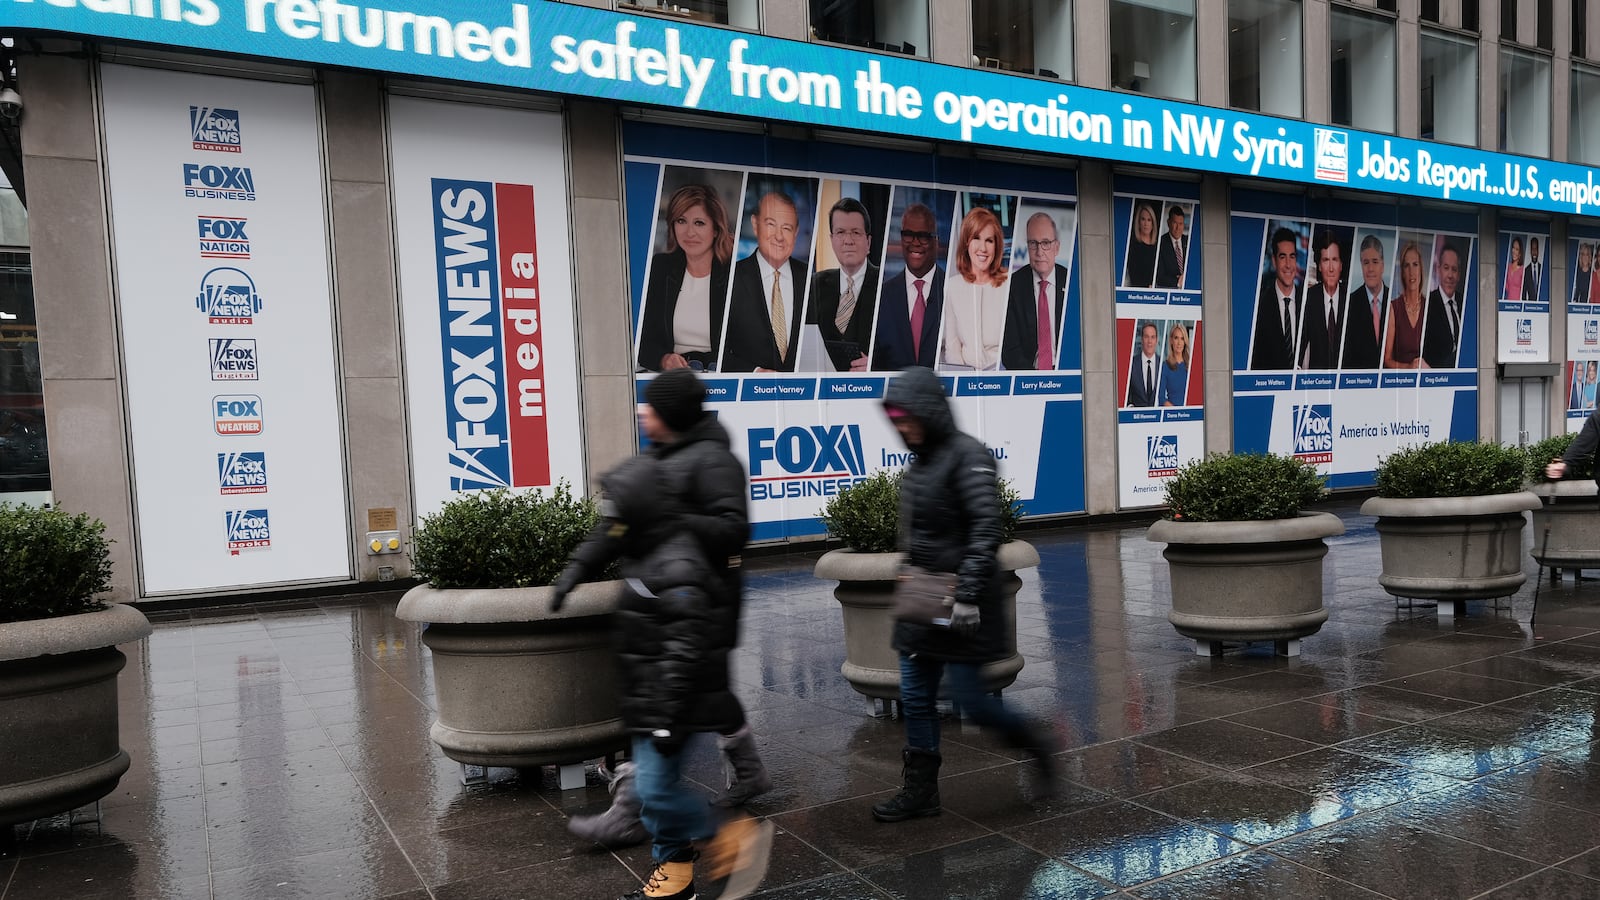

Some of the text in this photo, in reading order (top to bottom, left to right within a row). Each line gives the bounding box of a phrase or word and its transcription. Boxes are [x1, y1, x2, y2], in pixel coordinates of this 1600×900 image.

[245, 0, 532, 68] returned
[550, 21, 715, 107] safely
[727, 39, 842, 109] from
[853, 60, 922, 119] the
[933, 94, 1112, 143] operation
[1123, 104, 1152, 148] in
[1161, 110, 1224, 159] NW
[1232, 119, 1303, 175] Syria
[206, 116, 238, 131] FOX
[199, 130, 240, 144] NEWS
[194, 143, 241, 152] channel
[1356, 141, 1410, 184] Jobs
[183, 163, 243, 189] FOX
[185, 189, 256, 201] BUSINESS
[198, 219, 248, 240] FOX
[200, 241, 250, 253] NATION
[221, 292, 249, 307] FOX
[214, 305, 251, 316] NEWS
[440, 187, 501, 450] FOX NEWS
[505, 252, 543, 418] media
[226, 348, 254, 360] FOX
[219, 360, 255, 371] NEWS
[216, 372, 255, 380] digital
[753, 384, 805, 396] Stuart Varney
[831, 383, 873, 393] Neil Cavuto
[968, 382, 977, 390] Liz
[1021, 380, 1062, 391] Larry Kudlow
[216, 400, 259, 417] FOX
[218, 422, 260, 433] WEATHER
[1306, 416, 1330, 434] FOX
[1340, 420, 1430, 438] America is Watching
[1299, 434, 1331, 451] NEWS
[747, 425, 847, 476] FOX
[1157, 444, 1177, 456] FOX
[234, 460, 264, 474] FOX
[1152, 456, 1177, 468] NEWS
[226, 473, 266, 486] NEWS
[221, 486, 267, 495] international
[1133, 484, 1163, 493] America is
[240, 516, 268, 530] FOX
[233, 529, 270, 541] NEWS
[230, 540, 270, 550] books
